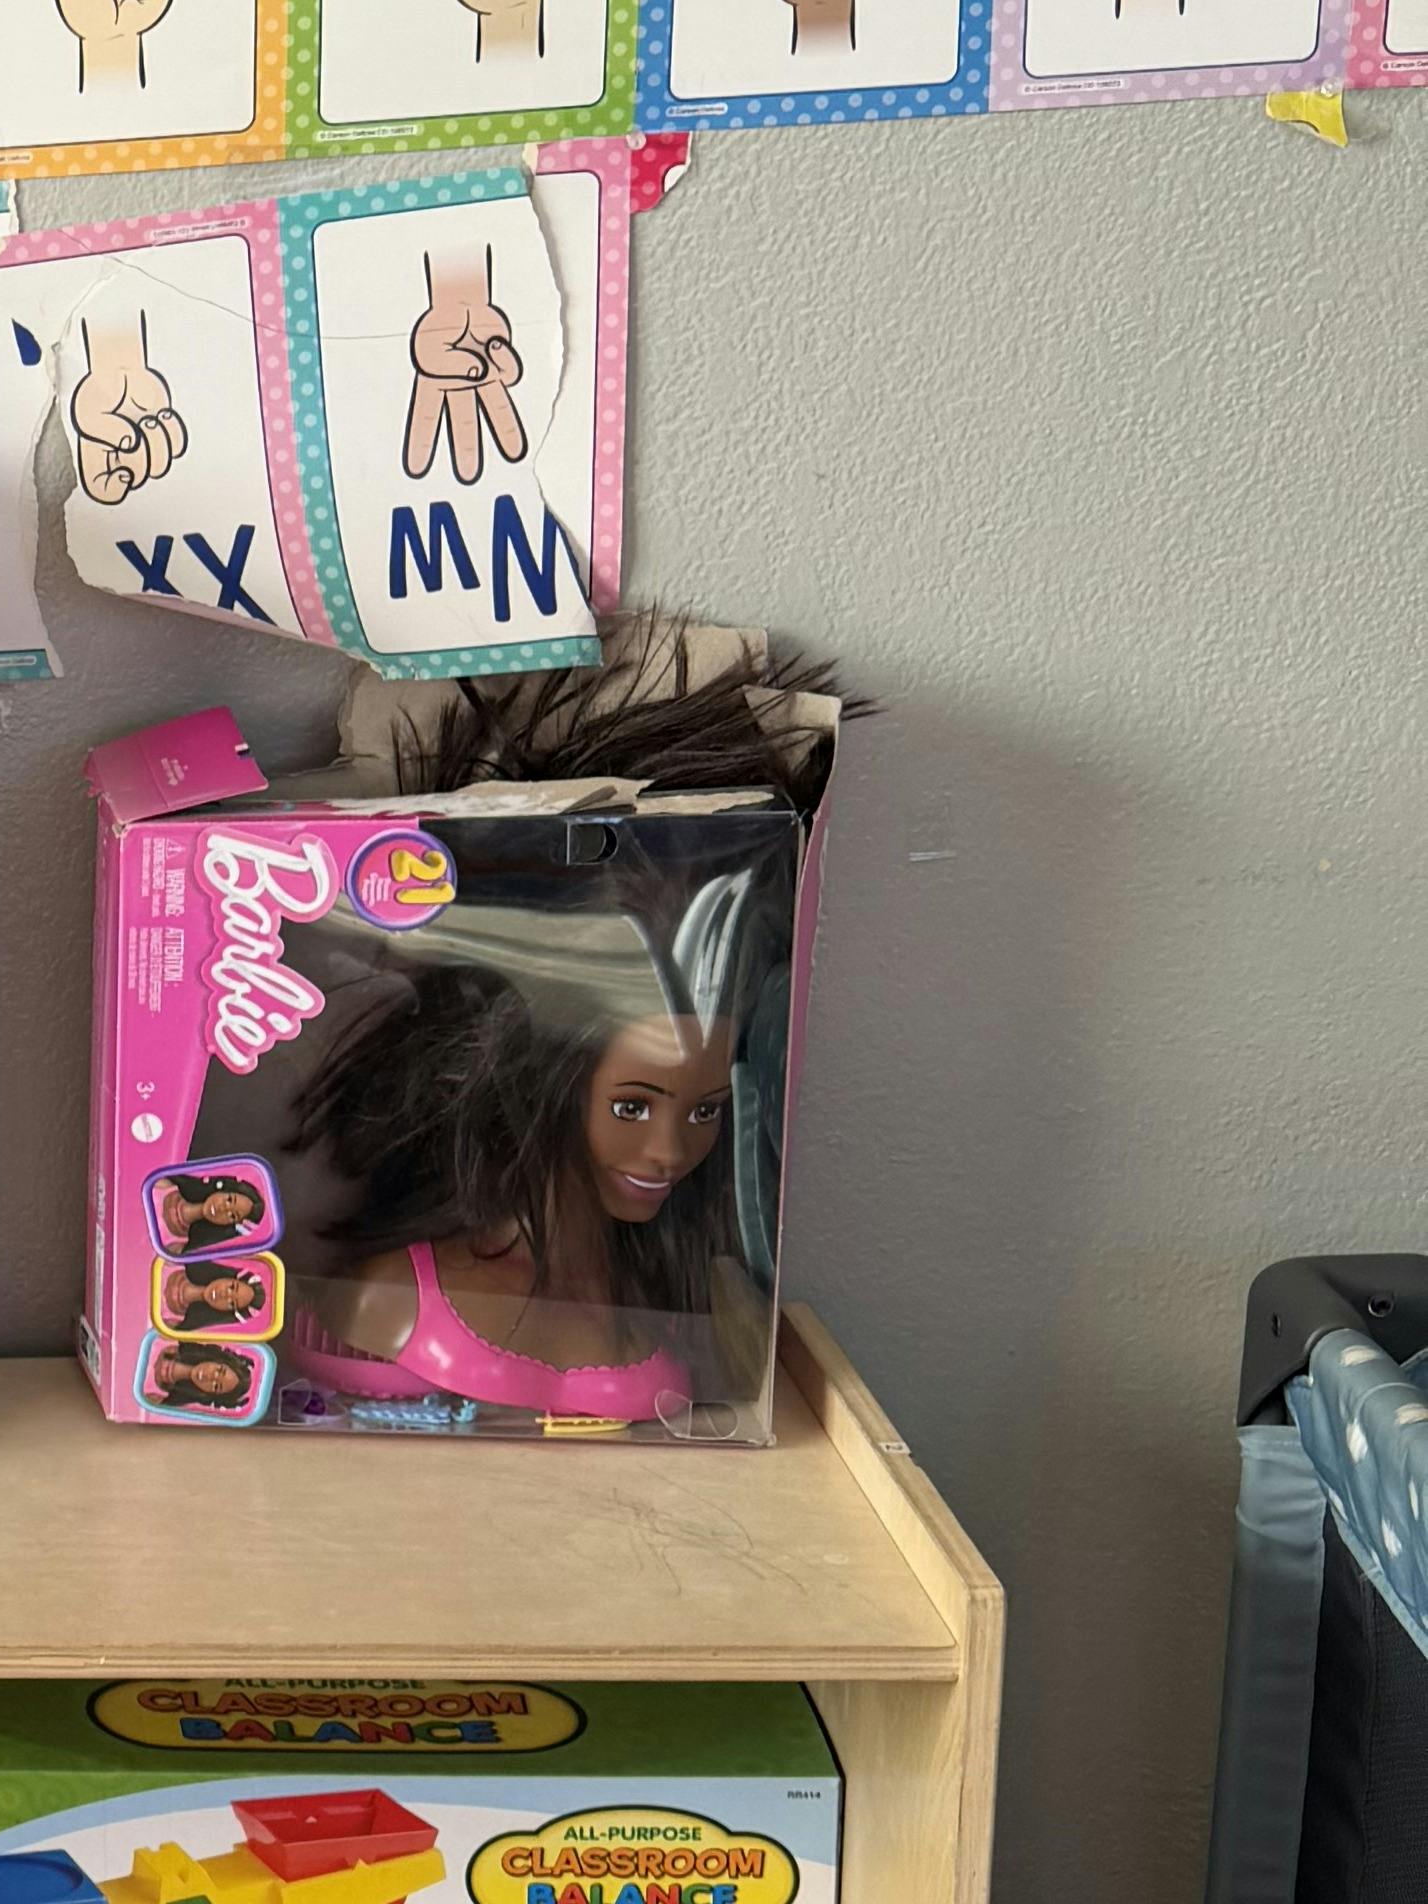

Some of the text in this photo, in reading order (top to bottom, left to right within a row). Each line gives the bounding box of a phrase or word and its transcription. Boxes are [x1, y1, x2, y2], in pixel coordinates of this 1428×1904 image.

[390, 849, 457, 906] 21
[203, 834, 330, 1067] Barbie
[136, 1080, 156, 1100] 3+
[137, 1690, 528, 1717] CLASSROOM
[179, 1717, 503, 1744] BALANCE
[564, 1826, 702, 1842] ALL-PURPOSE
[502, 1847, 766, 1879] CLASSROOM
